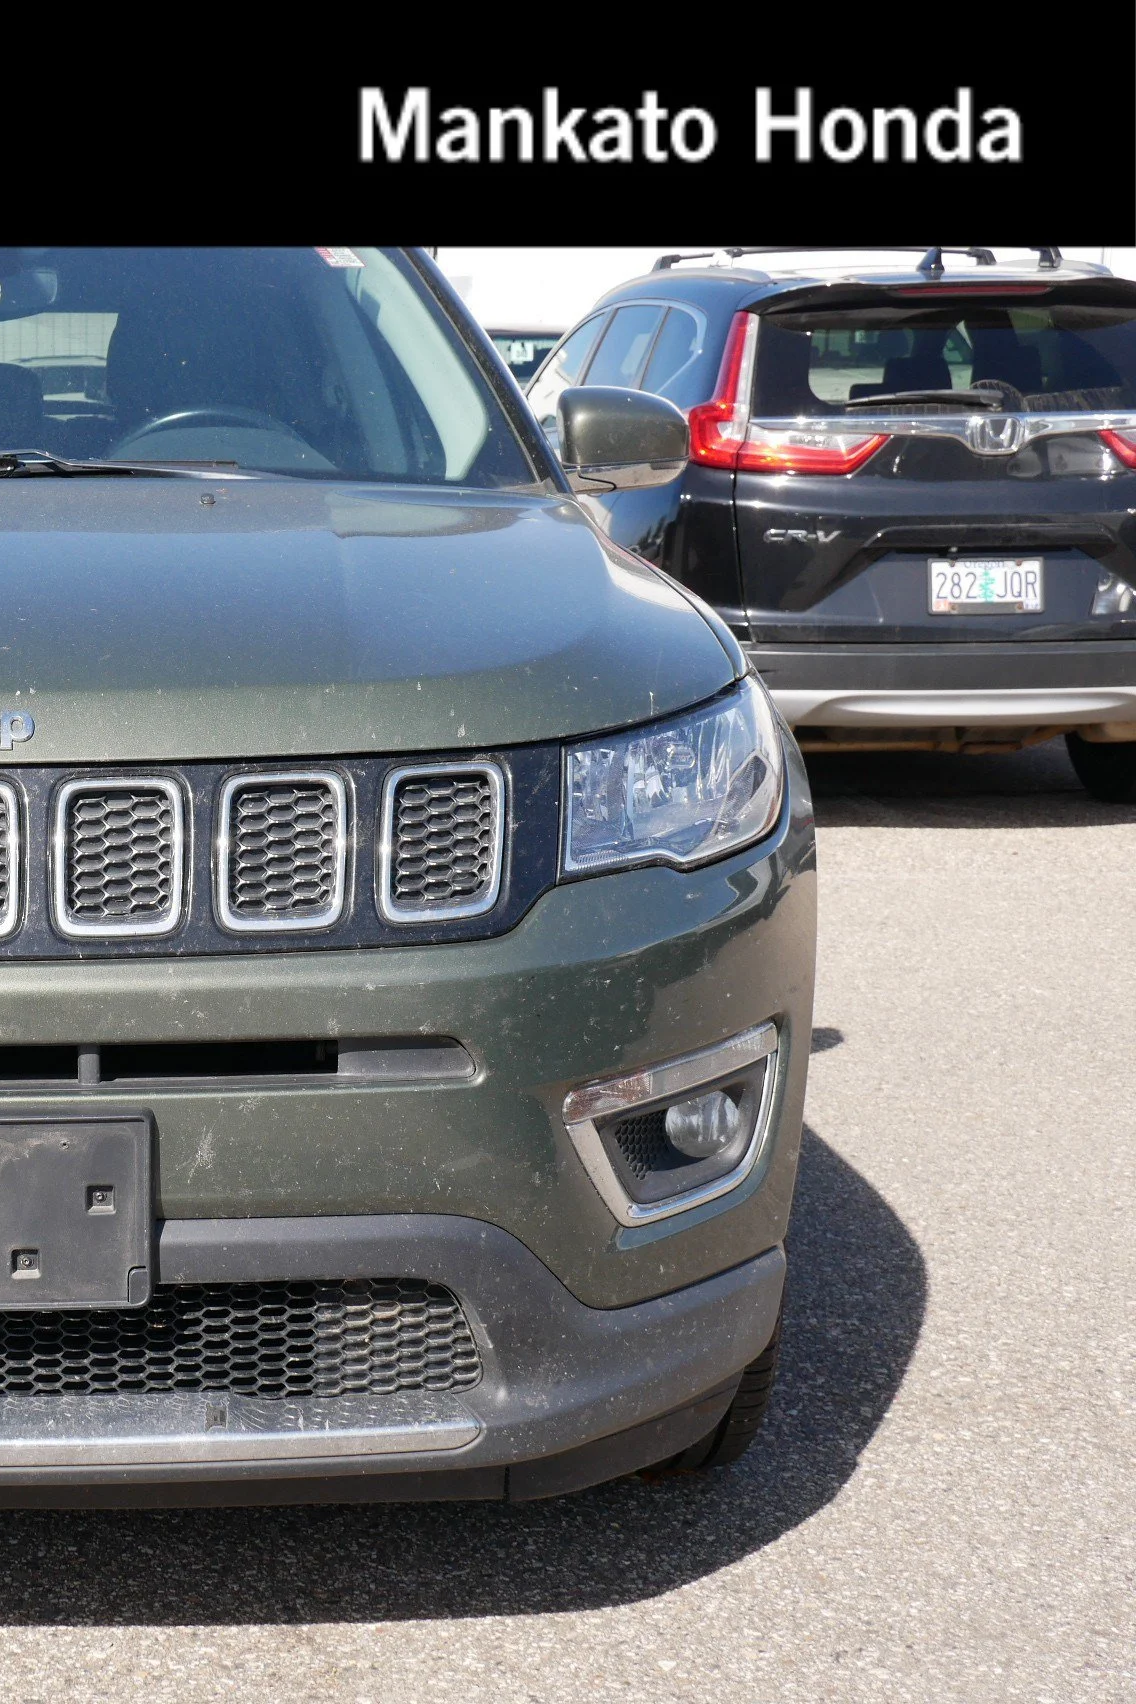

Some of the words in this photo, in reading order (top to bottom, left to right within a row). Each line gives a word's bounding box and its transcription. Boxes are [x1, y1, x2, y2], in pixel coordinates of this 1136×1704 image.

[763, 529, 841, 544] CR-V
[935, 572, 978, 599] 282
[996, 571, 1037, 598] JQR
